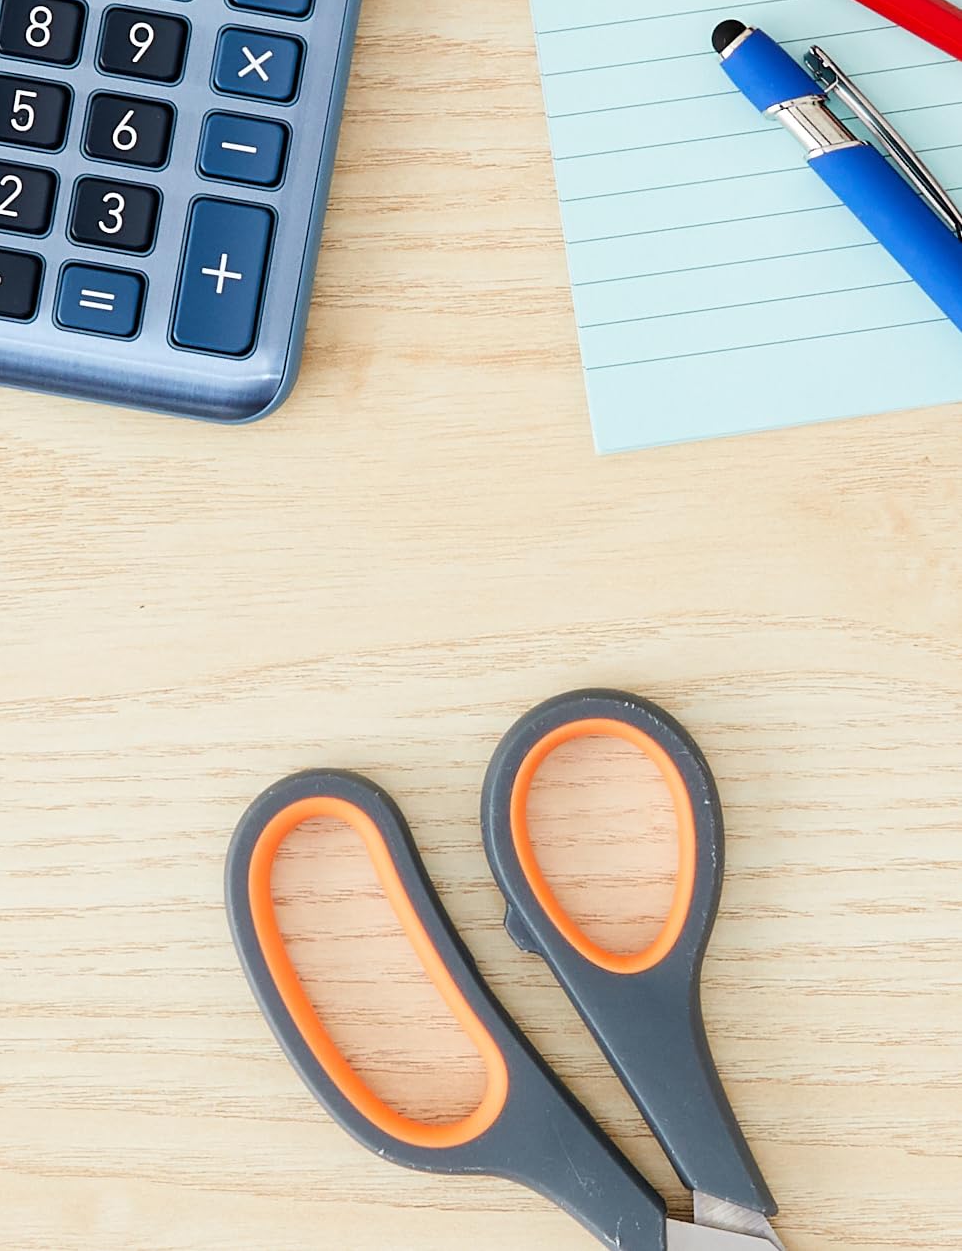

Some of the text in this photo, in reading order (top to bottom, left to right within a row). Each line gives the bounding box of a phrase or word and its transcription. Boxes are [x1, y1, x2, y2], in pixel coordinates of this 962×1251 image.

[25, 5, 53, 48] 8
[129, 22, 154, 63] 9
[10, 89, 38, 132] 5
[112, 109, 137, 151] 6
[98, 192, 125, 234] 3
